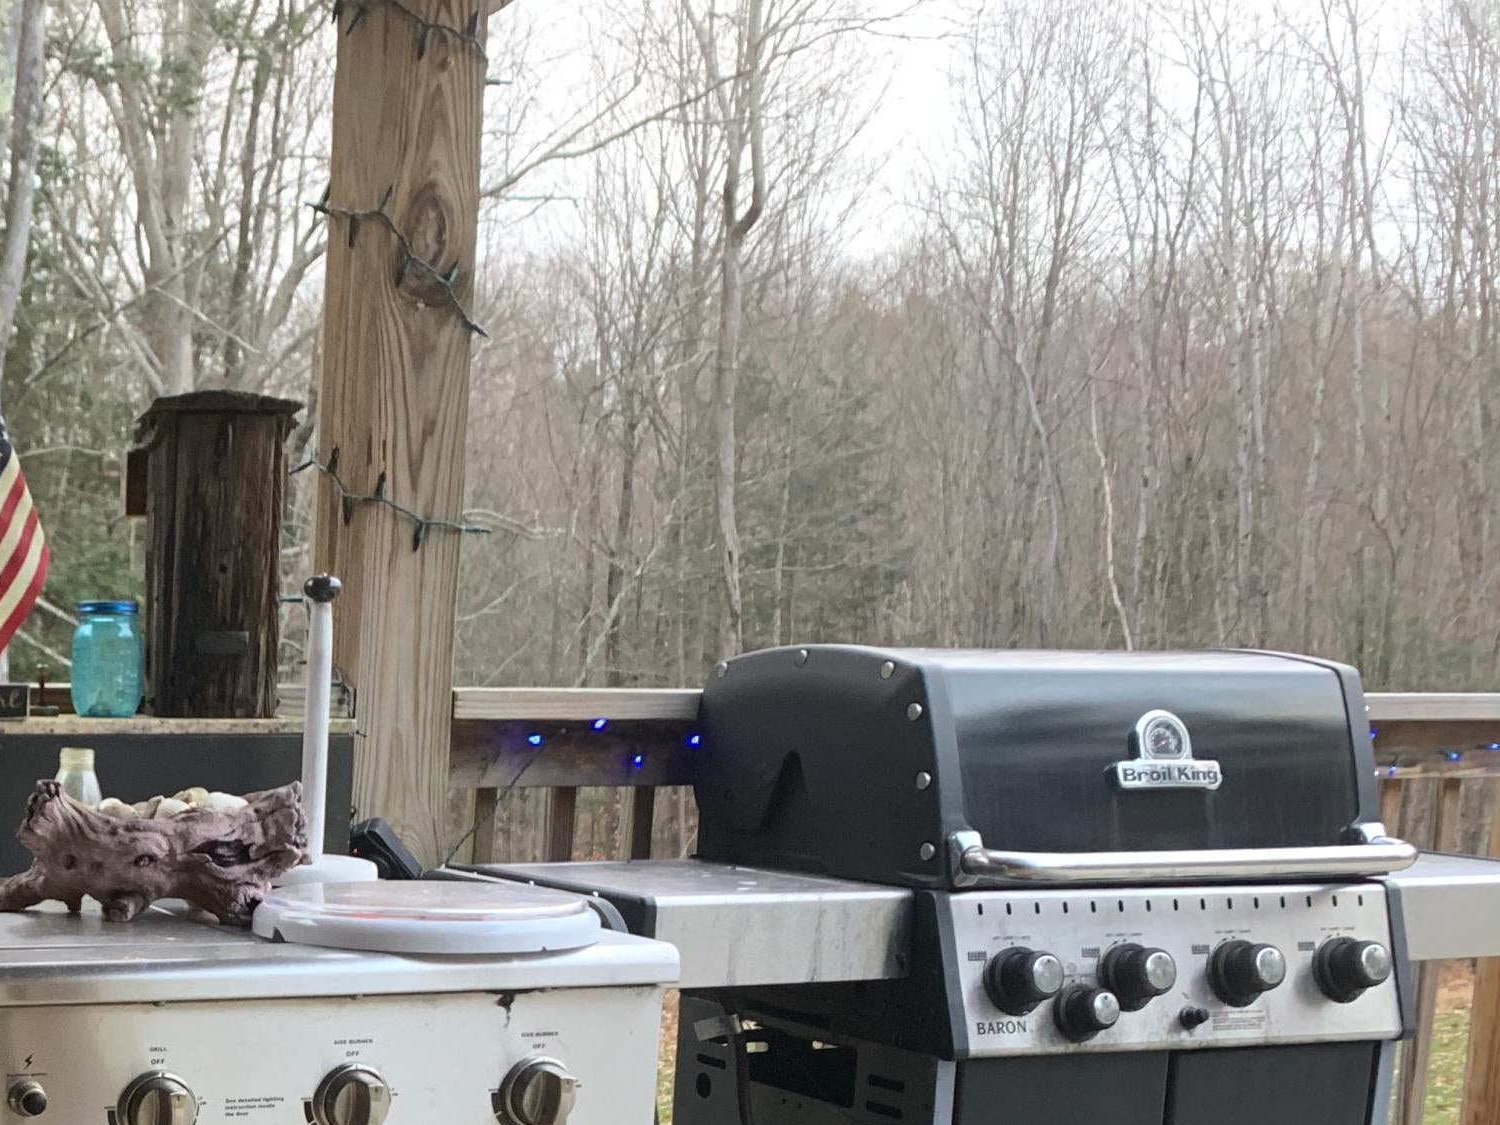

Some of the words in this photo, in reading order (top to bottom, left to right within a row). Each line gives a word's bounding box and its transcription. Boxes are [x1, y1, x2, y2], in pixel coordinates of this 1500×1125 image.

[1122, 766, 1173, 782] Broil
[1177, 766, 1218, 784] King
[976, 1020, 1028, 1036] BARON
